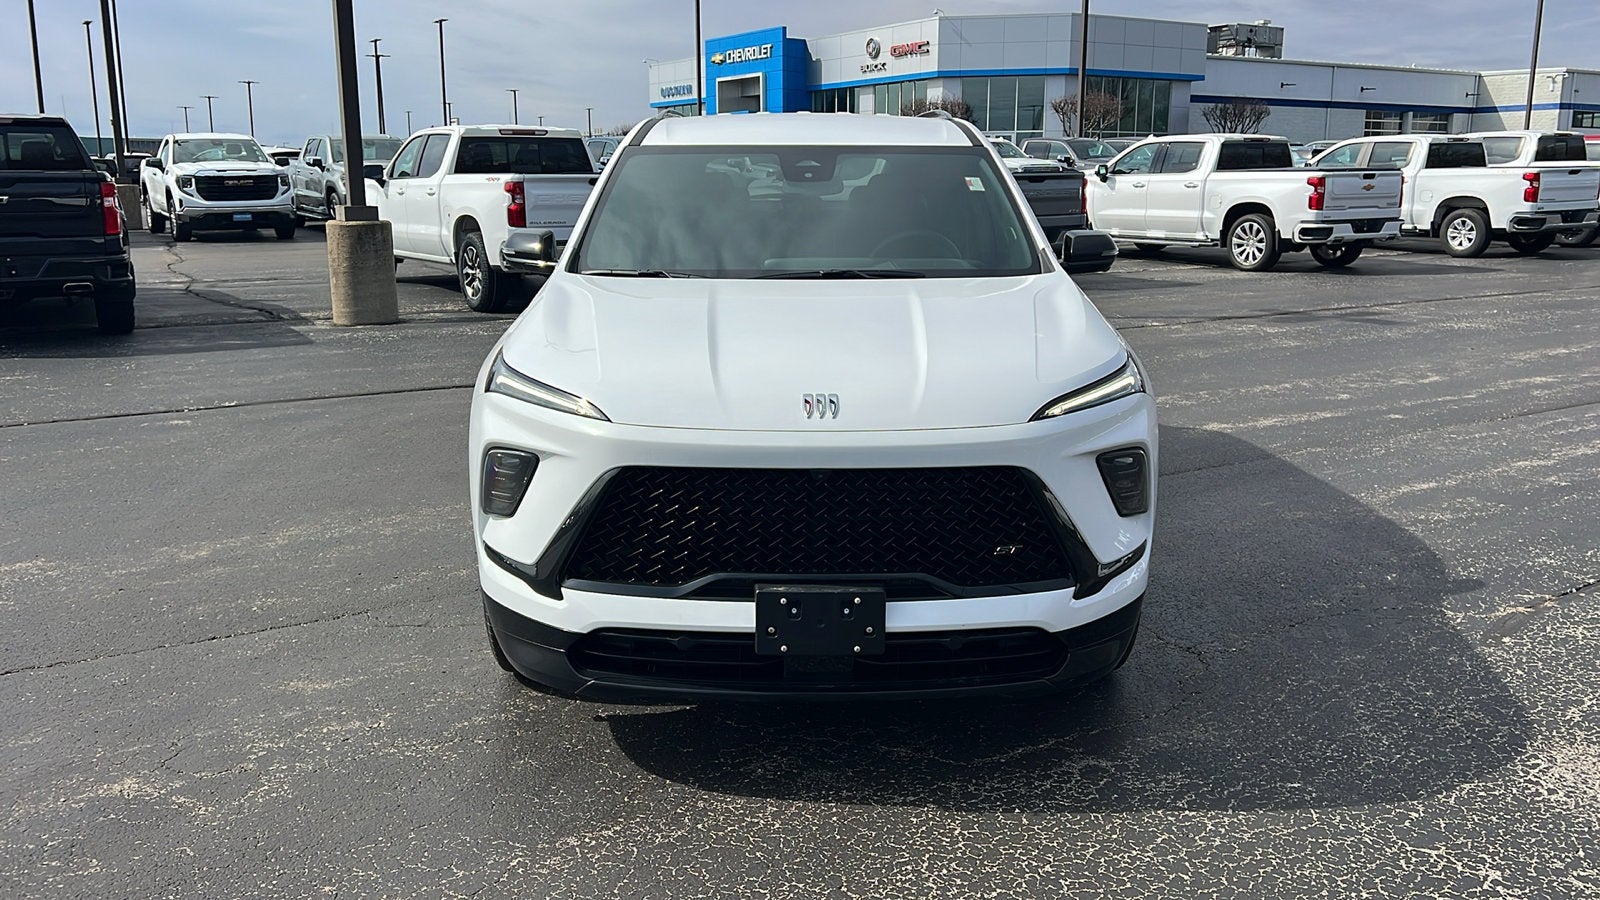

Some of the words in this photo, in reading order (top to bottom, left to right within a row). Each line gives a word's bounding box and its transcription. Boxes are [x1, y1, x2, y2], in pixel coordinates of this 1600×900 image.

[726, 43, 773, 63] CHEVROLET
[890, 41, 930, 57] GMC
[860, 62, 887, 73] BUICK
